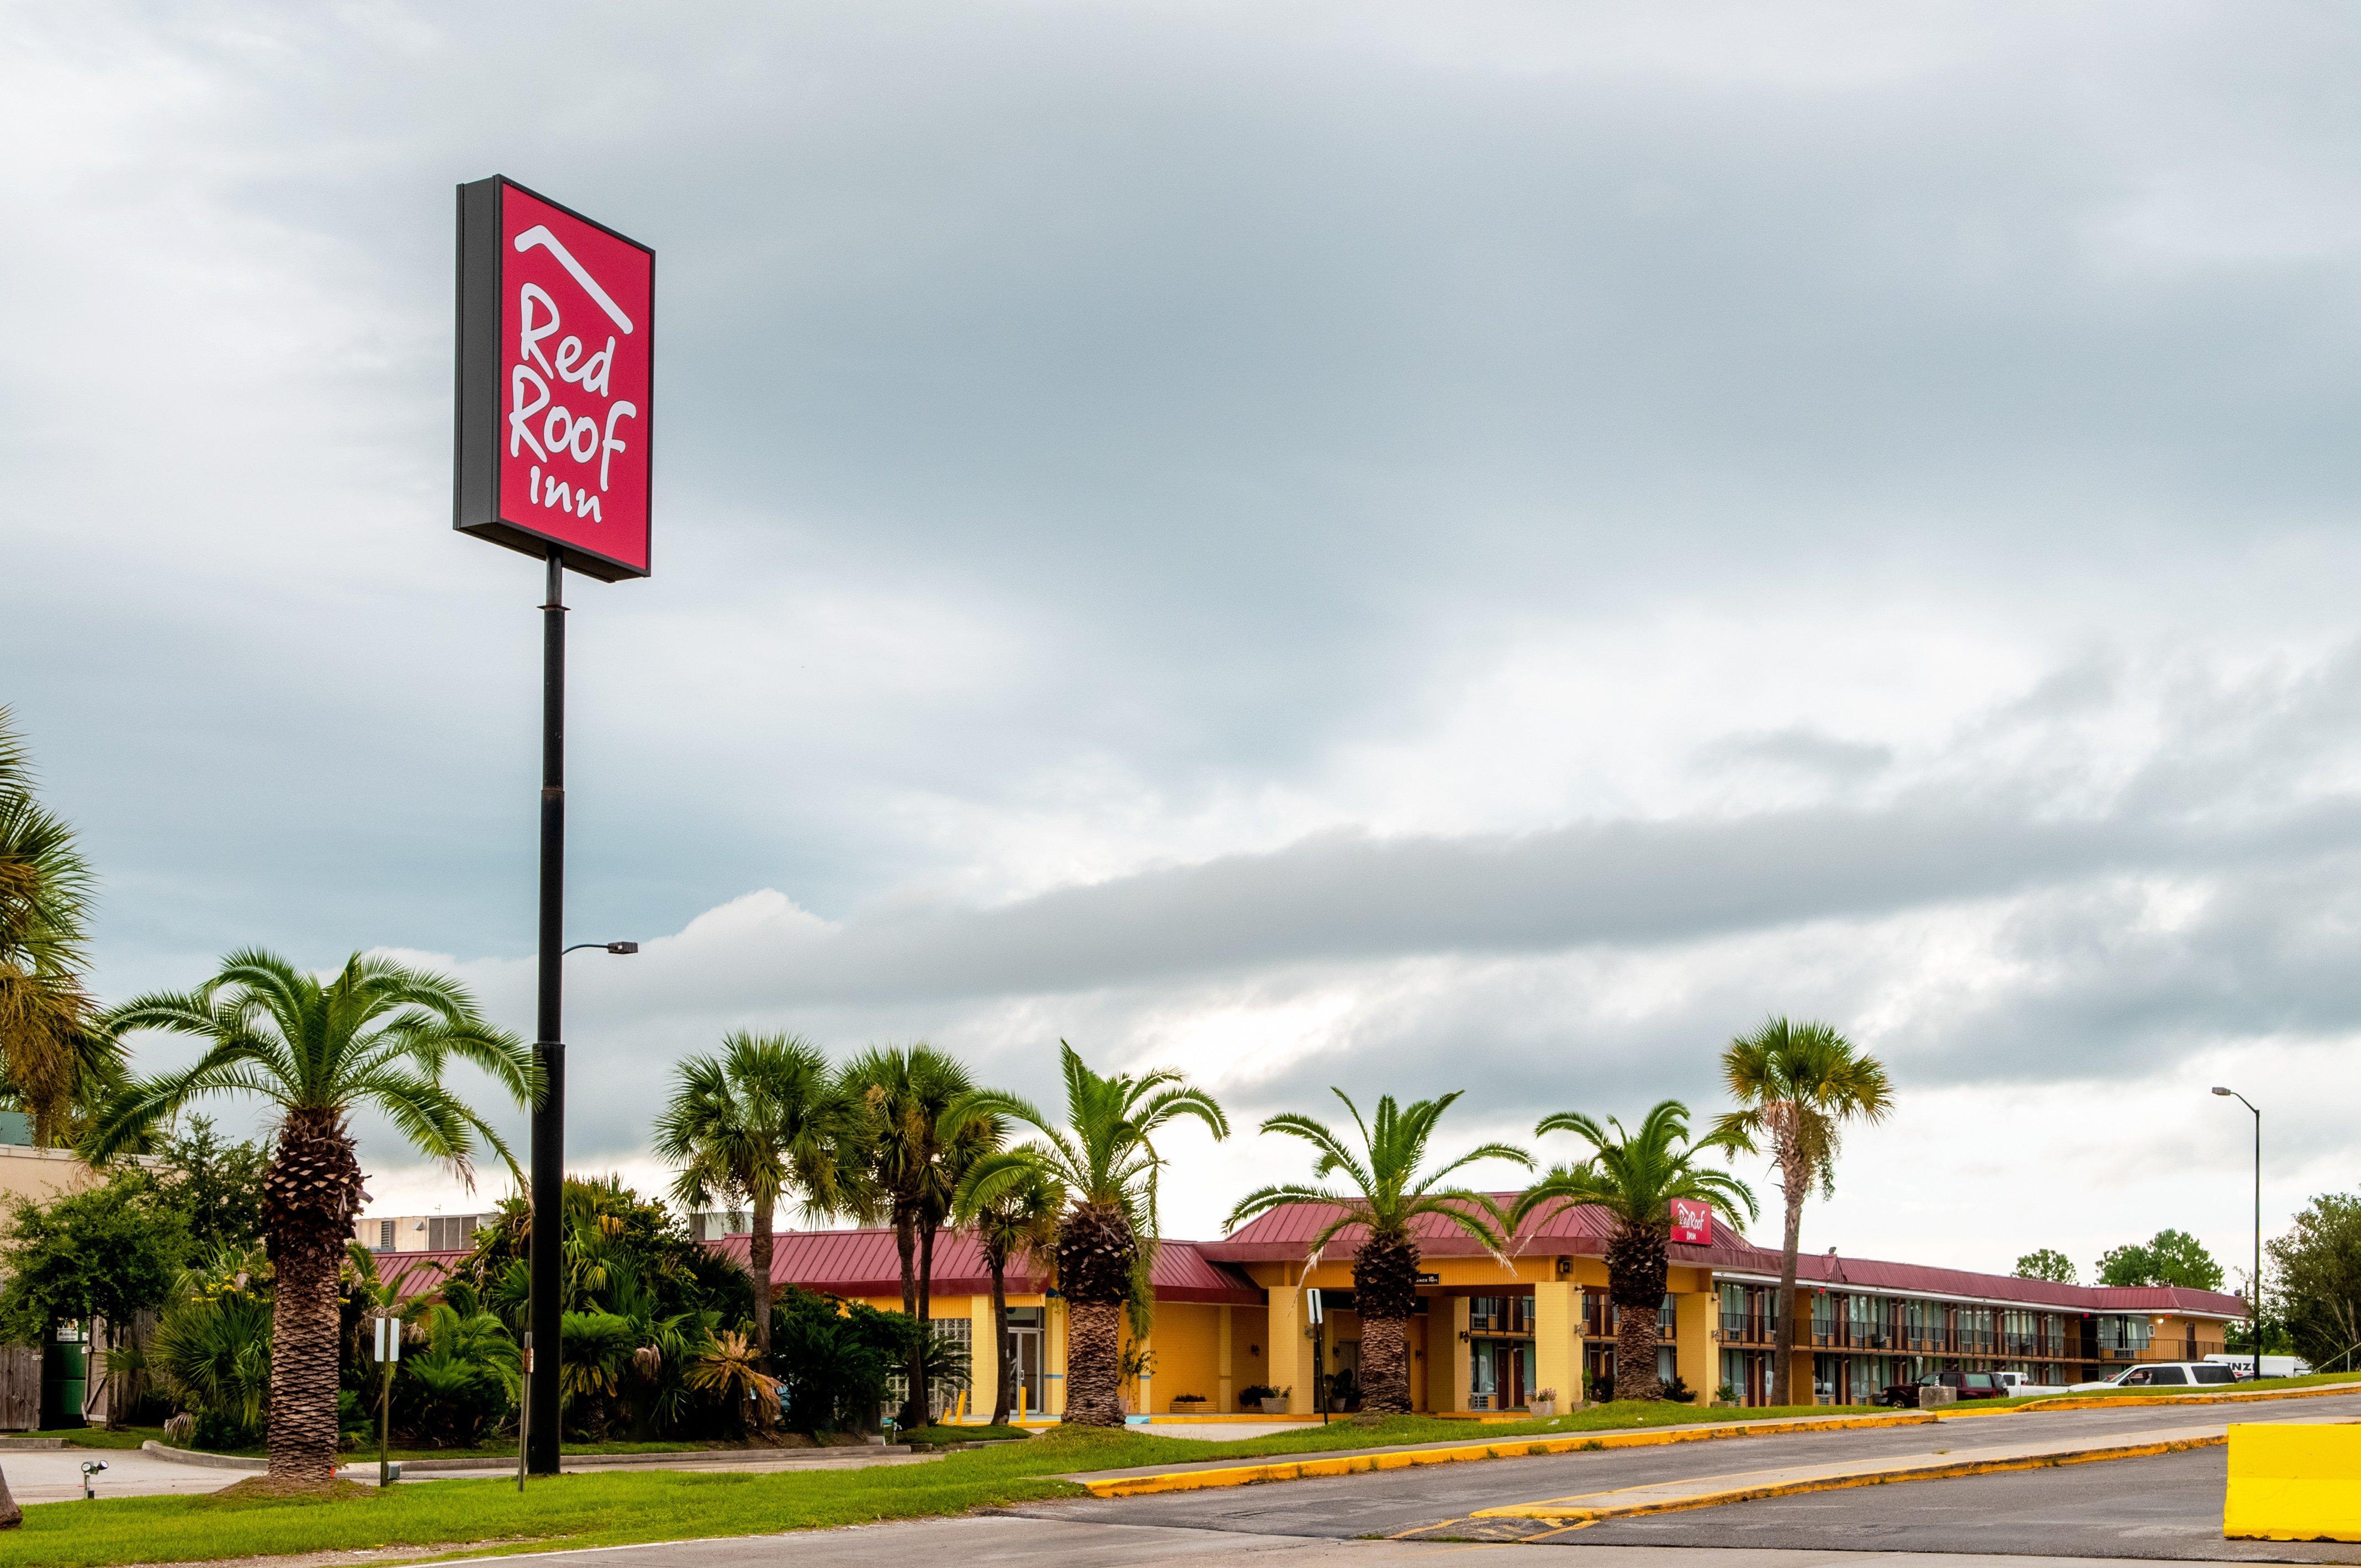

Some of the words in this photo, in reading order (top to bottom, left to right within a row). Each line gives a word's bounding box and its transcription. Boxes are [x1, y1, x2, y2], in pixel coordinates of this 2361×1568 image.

[520, 282, 615, 398] Red
[509, 364, 637, 492] Roof
[1679, 1209, 1691, 1228] Red
[1690, 1210, 1705, 1231] Roof
